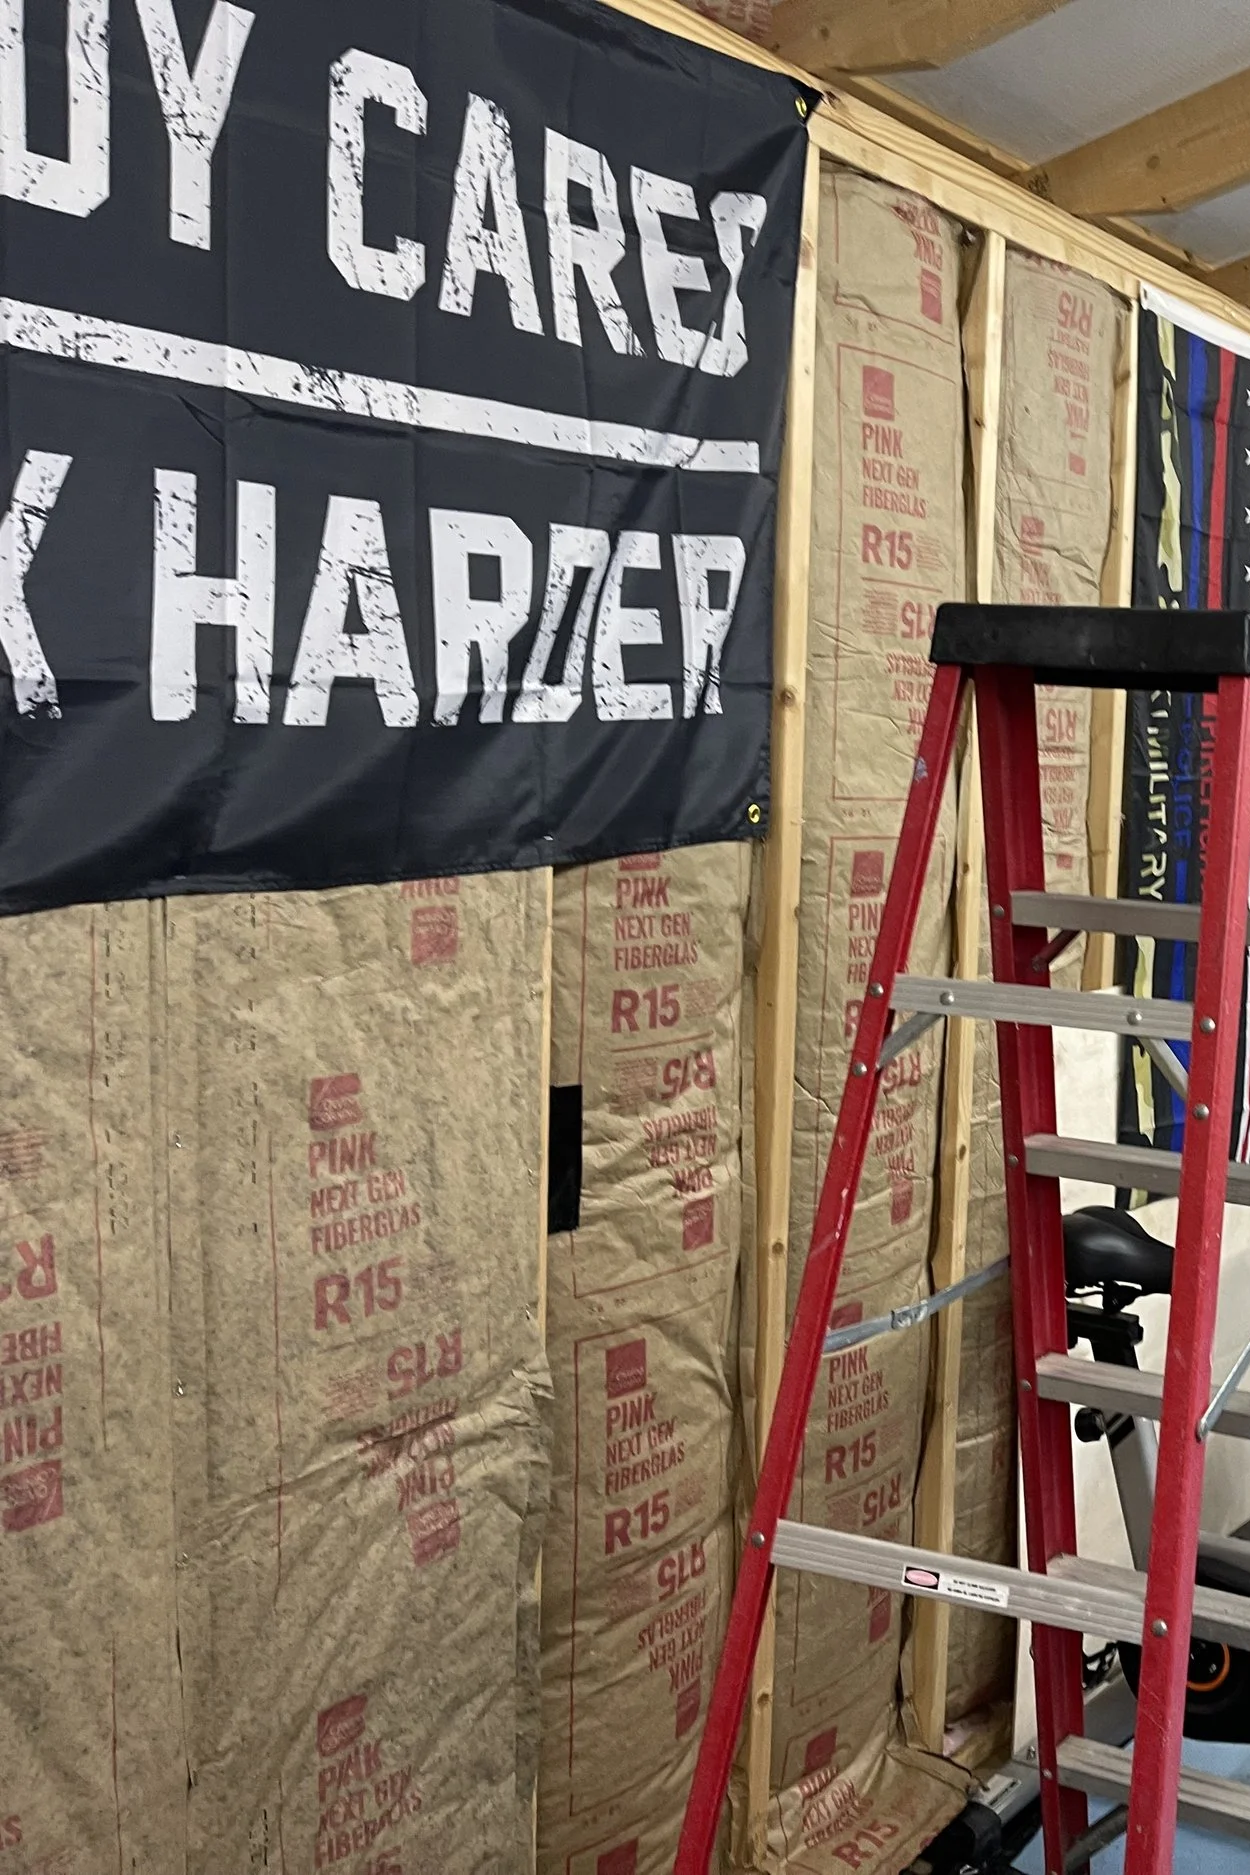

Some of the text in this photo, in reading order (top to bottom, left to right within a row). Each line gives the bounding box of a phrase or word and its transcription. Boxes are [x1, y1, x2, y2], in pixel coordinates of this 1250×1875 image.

[328, 48, 767, 378] CARES
[1057, 291, 1094, 338] R15
[862, 422, 903, 459] PINK
[861, 457, 920, 490] NEXT GEN
[862, 487, 927, 521] FIBERGLAS
[861, 524, 914, 571] R15
[150, 467, 747, 728] HARDER
[1046, 707, 1078, 743] R15
[1171, 723, 1194, 850] POLICE
[1138, 725, 1171, 901] MILITARY
[616, 877, 672, 909] PINK
[614, 913, 692, 941] NEXT GEN
[614, 941, 698, 972] FIBERGLAS
[611, 984, 681, 1034] R15
[662, 1047, 717, 1099] R15
[880, 1050, 922, 1099] R15
[309, 1131, 377, 1179] PINK
[310, 1168, 407, 1219] NEXT GEN
[311, 1201, 422, 1255] FIBERGLAS
[314, 1255, 404, 1331] R15
[0, 1362, 63, 1405] NEX
[386, 1326, 463, 1402] R15
[827, 1369, 884, 1408] NEXT GEN
[828, 1345, 870, 1383] PINK
[2, 1405, 64, 1463] PIN
[605, 1391, 657, 1439] PINK
[826, 1390, 891, 1434] FIBERGLAS
[605, 1416, 677, 1467] NEXT GEN
[825, 1430, 877, 1485] R15
[604, 1441, 686, 1497] FIBERGLAS
[604, 1488, 670, 1554] R15
[862, 1470, 902, 1527] R15
[657, 1539, 707, 1601] R15
[668, 1641, 704, 1693] PINK
[319, 1737, 382, 1804] PINK
[832, 1820, 900, 1870] R15
